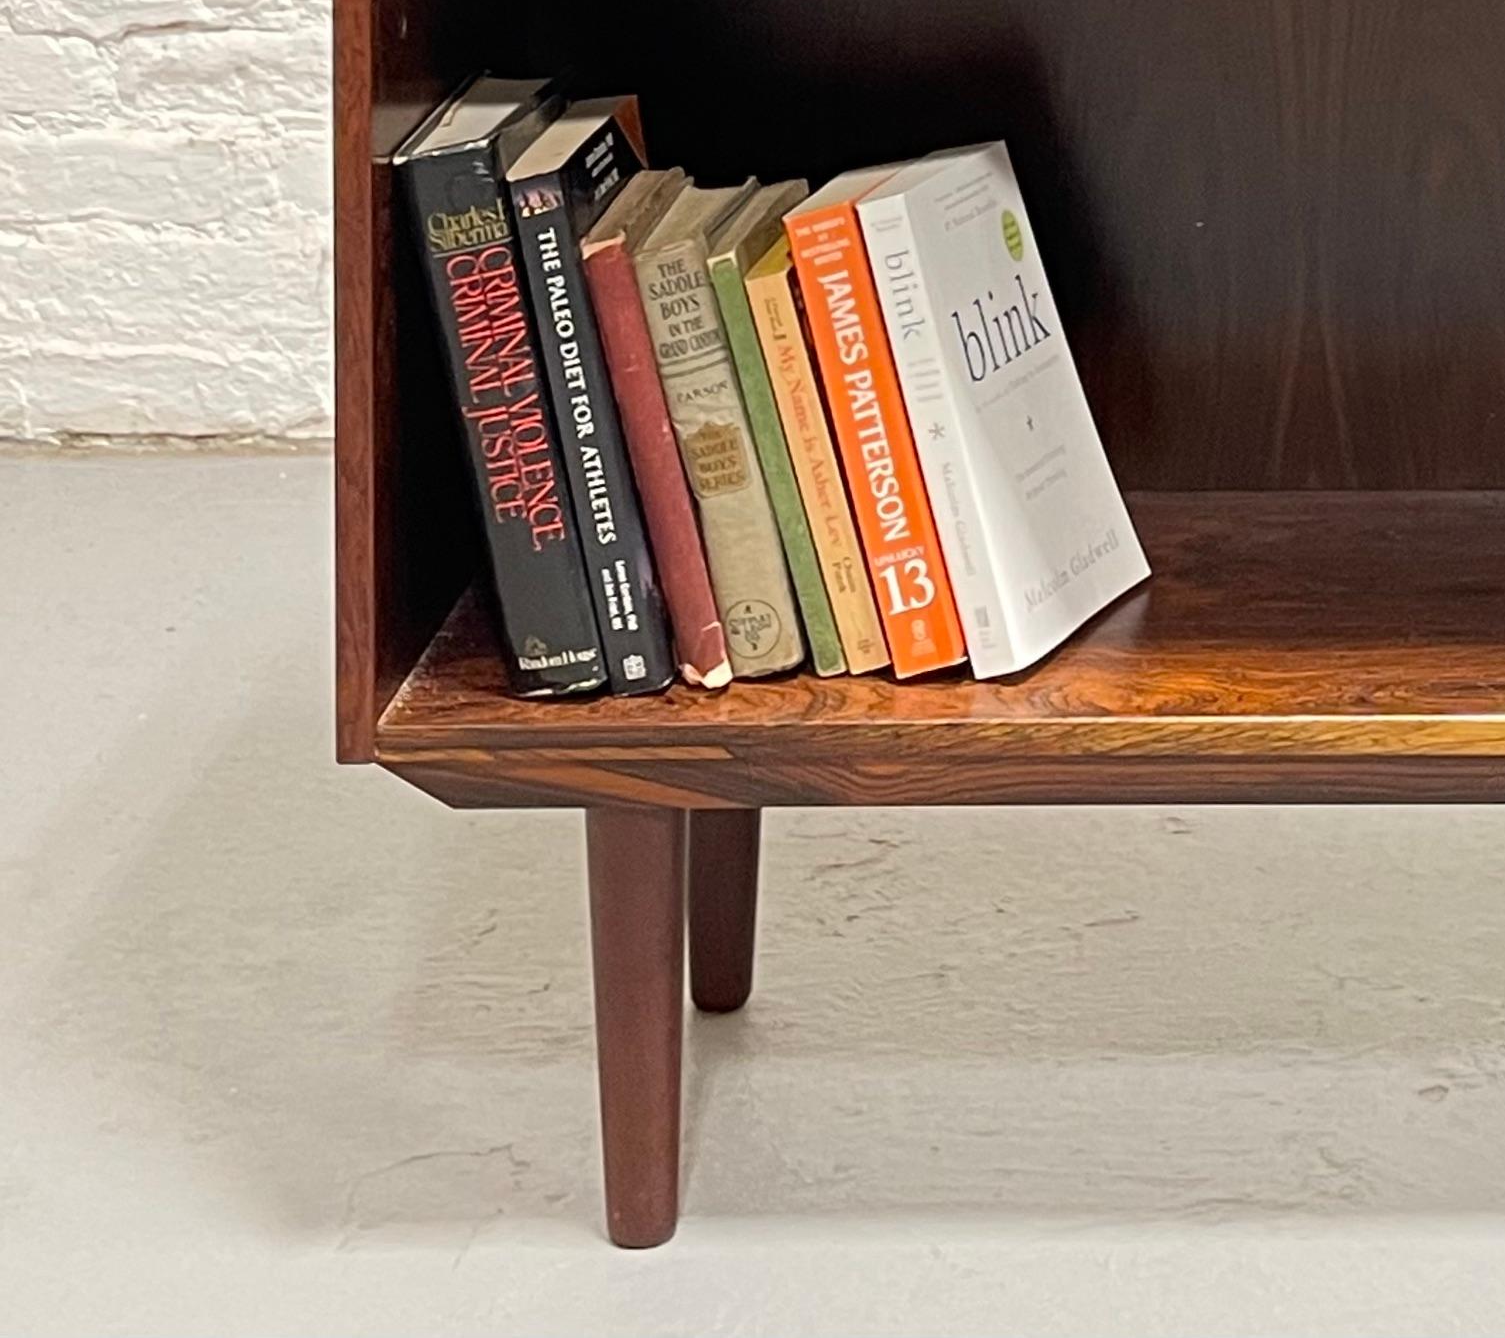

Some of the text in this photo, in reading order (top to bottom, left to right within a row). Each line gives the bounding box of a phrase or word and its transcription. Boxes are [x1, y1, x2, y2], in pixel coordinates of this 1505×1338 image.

[649, 270, 706, 301] SADDLE
[657, 258, 686, 279] THE
[885, 250, 925, 341] blink
[660, 294, 700, 319] BOYS
[669, 317, 705, 338] IN THE
[951, 274, 1051, 382] blink
[447, 255, 526, 523] CRIMINAL JUSTICE
[478, 246, 566, 552] CRIMINAL VIOLENCE
[538, 227, 617, 545] THE PALEO DIET FOR ATHLETES
[677, 380, 729, 404] CARSON
[817, 269, 869, 366] JAMES
[843, 369, 912, 542] PATTERSON
[777, 342, 797, 379] My
[788, 377, 809, 432] Name
[810, 457, 833, 508] Asher
[874, 546, 925, 567] UNLUCKY
[879, 557, 936, 616] 13
